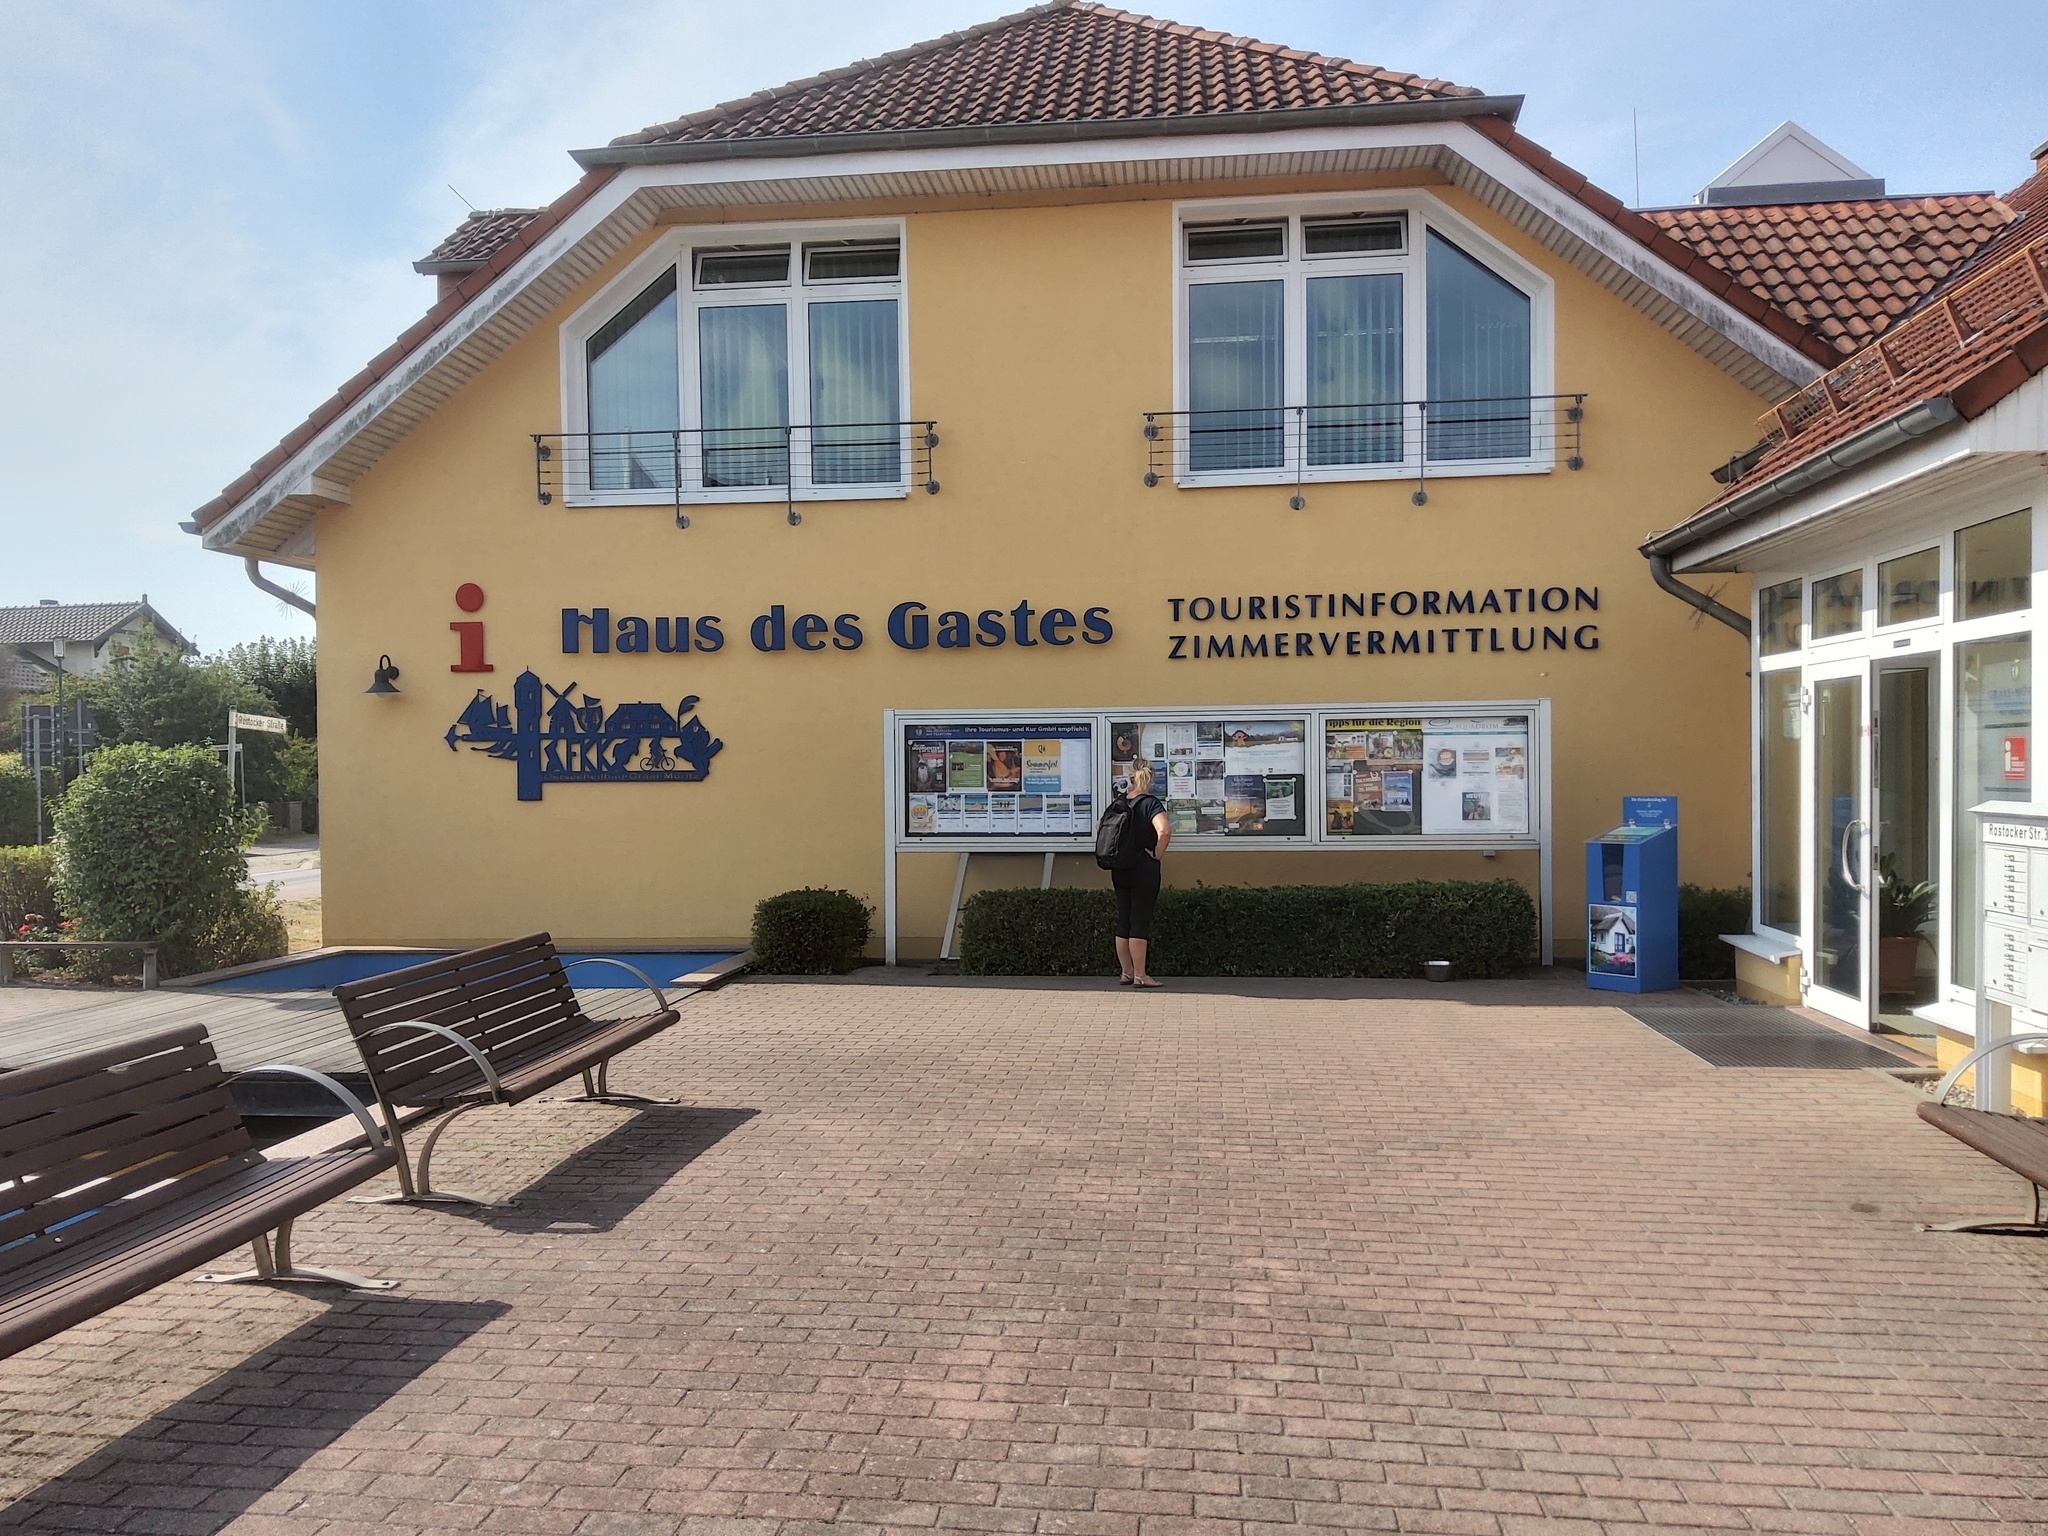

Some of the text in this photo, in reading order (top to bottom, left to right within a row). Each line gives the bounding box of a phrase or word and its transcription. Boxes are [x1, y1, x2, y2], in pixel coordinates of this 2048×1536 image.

[1167, 586, 1599, 622] TOURISTINFORMATION
[561, 599, 1114, 654] Haus des Gastes
[1167, 624, 1599, 659] ZIMMERVERMITTLUNG
[1988, 823, 2028, 839] Rostocker
